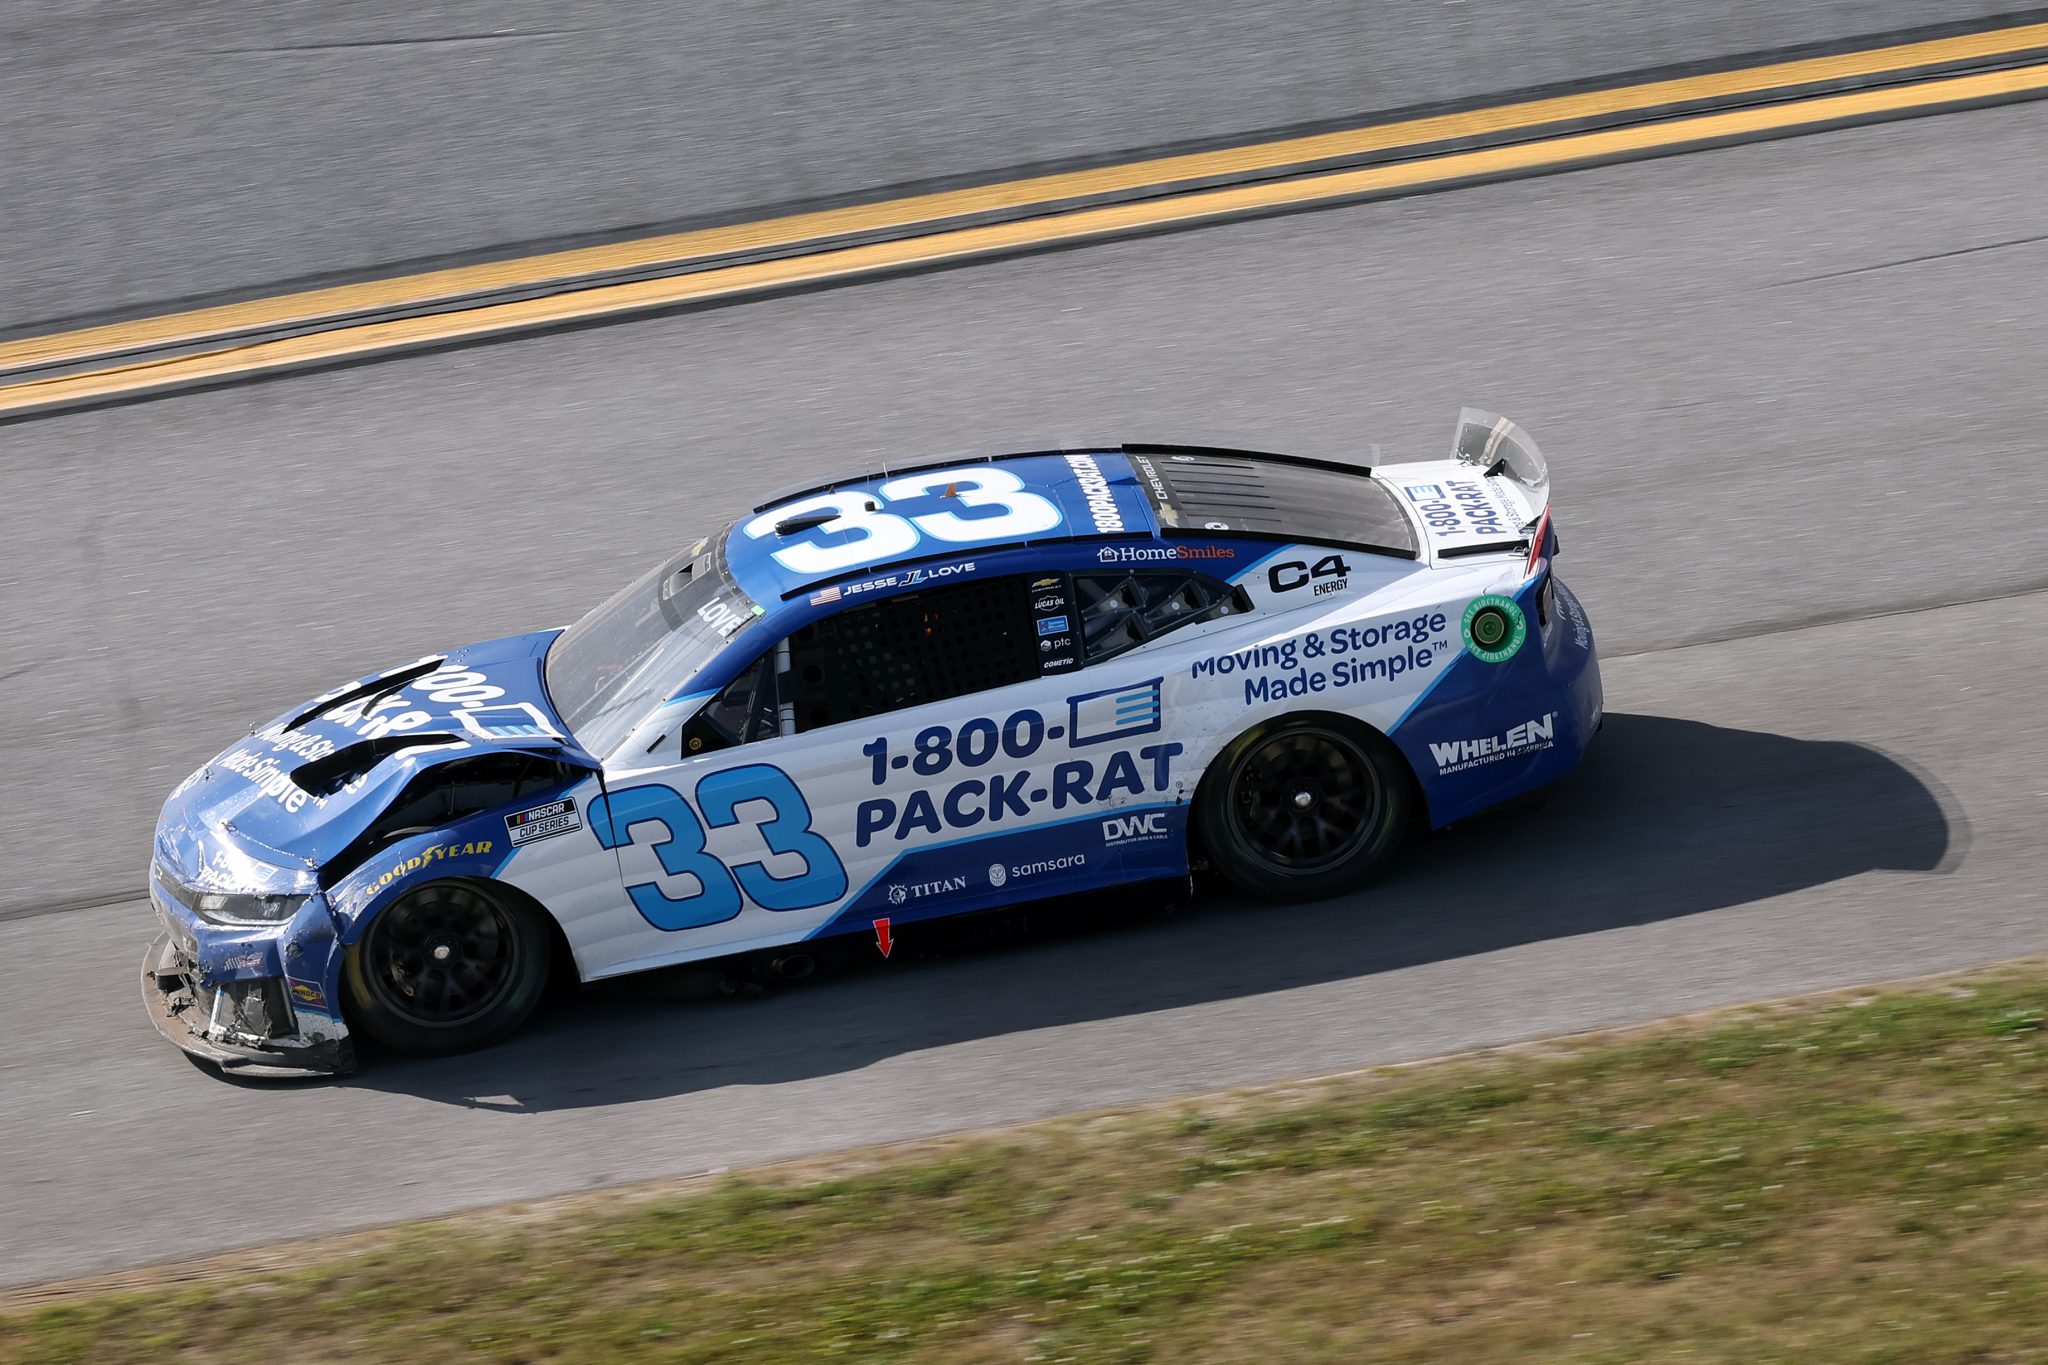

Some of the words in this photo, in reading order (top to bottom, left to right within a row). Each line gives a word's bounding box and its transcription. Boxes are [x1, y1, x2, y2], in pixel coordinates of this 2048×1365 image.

[1135, 455, 1168, 500] CHEVROLET
[742, 467, 1063, 574] 33
[1445, 480, 1508, 535] PACK-RAT
[1120, 545, 1235, 561] HomeSmiles
[843, 577, 898, 596] JESSE
[928, 562, 976, 579] LOVE
[1267, 554, 1351, 593] C4
[1313, 578, 1348, 596] ENERGY
[1034, 599, 1054, 609] LUCAS
[1054, 637, 1071, 650] ptc
[1192, 639, 1299, 679] Moving
[1302, 633, 1326, 658] &
[1330, 612, 1446, 654] Storage
[1244, 667, 1326, 706] Made
[862, 709, 1065, 786] 1-800-
[1428, 712, 1554, 767] WHELEN
[1439, 752, 1505, 776] MANUFACTURED
[528, 803, 565, 821] NASCAR
[856, 742, 1184, 848] PACK-RAT
[519, 825, 538, 838] CUP
[539, 817, 569, 832] SERIES
[1102, 813, 1167, 840] DWC
[586, 762, 849, 932] 33
[1012, 853, 1086, 877] samsara
[366, 841, 492, 896] GOODYEAR
[911, 876, 966, 897] TITAN
